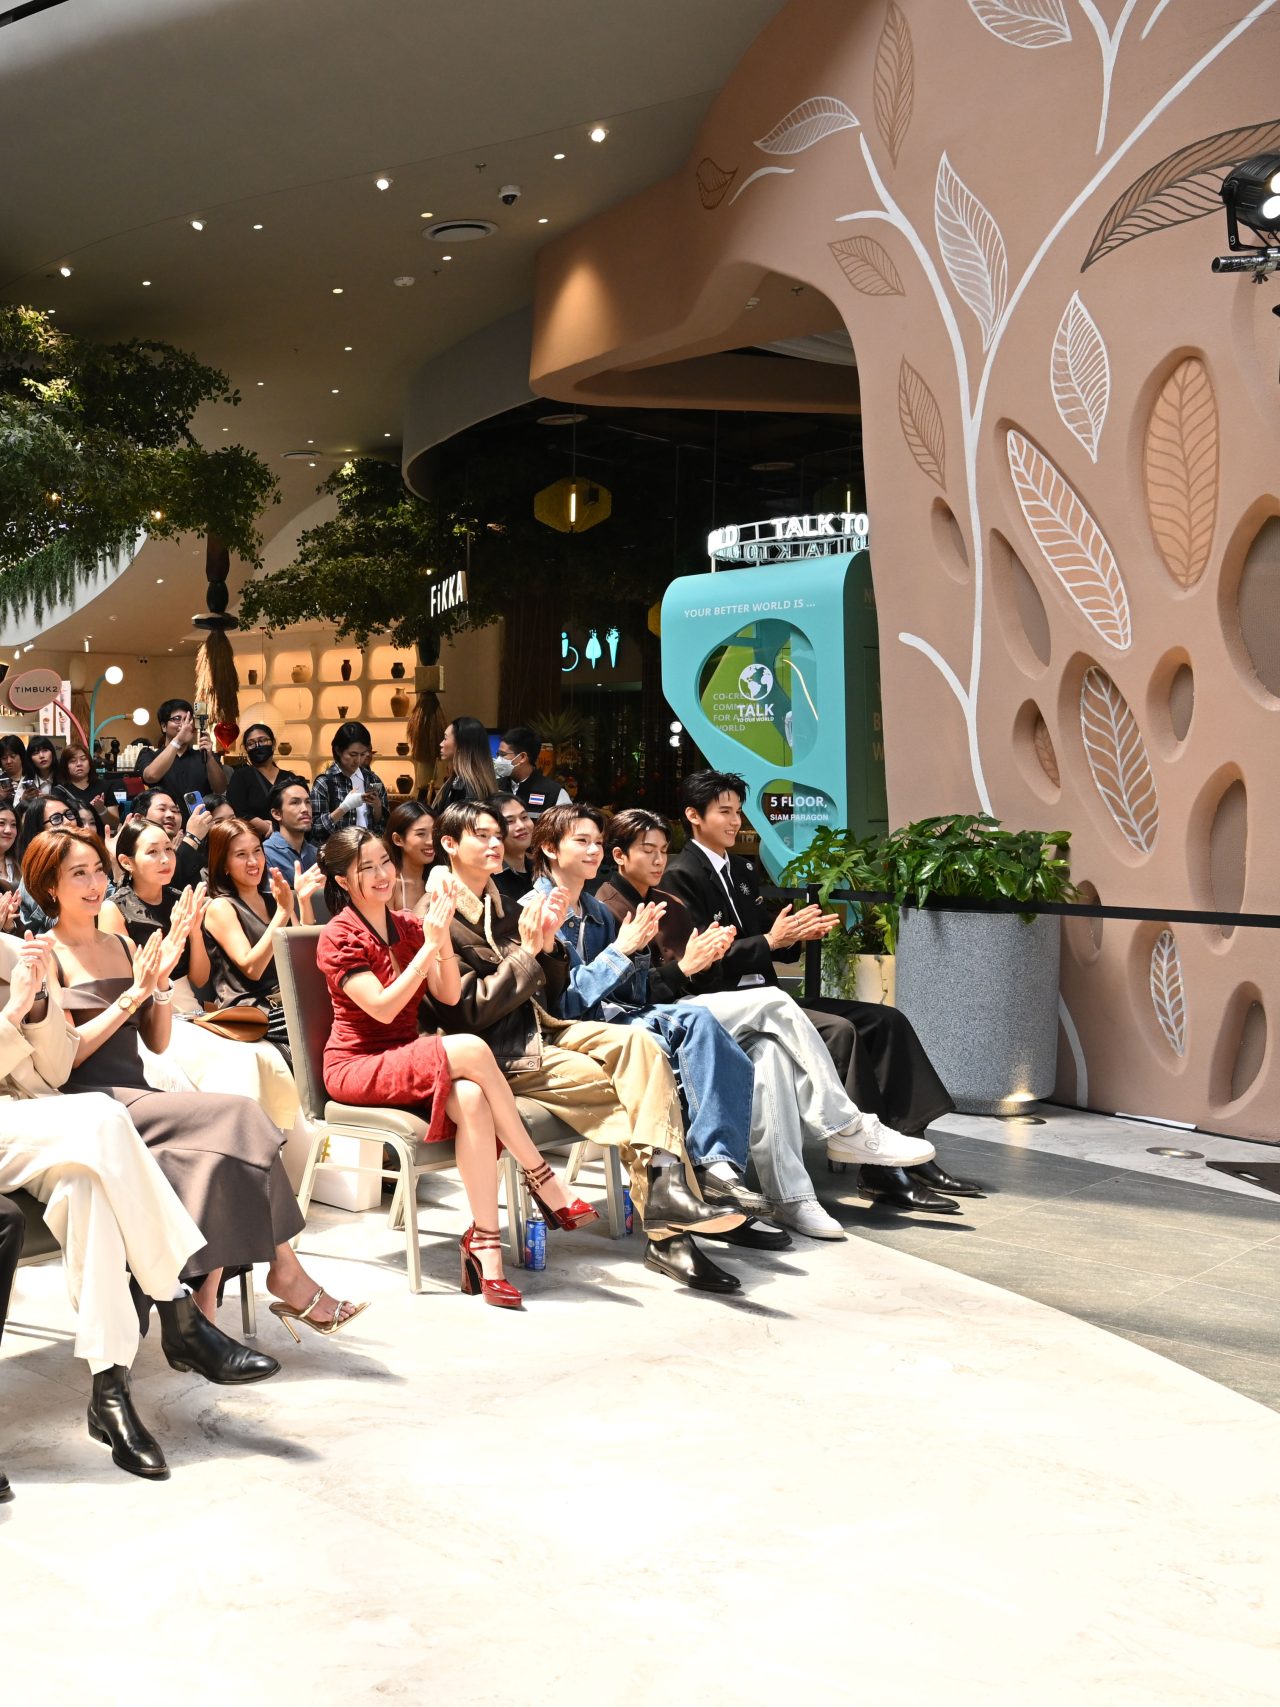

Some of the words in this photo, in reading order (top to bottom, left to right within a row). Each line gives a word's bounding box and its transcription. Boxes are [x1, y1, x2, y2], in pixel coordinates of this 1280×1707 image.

[770, 513, 835, 539] TALK
[840, 512, 869, 536] TO
[683, 607, 711, 619] YOUR
[713, 603, 750, 616] BETTER
[752, 600, 791, 612] WORLD
[793, 598, 804, 609] IS
[15, 686, 58, 694] TIMBUK2
[737, 703, 774, 717] TALK
[720, 724, 746, 732] ORLD
[770, 796, 778, 807] 5
[781, 796, 828, 808] FLOOR,
